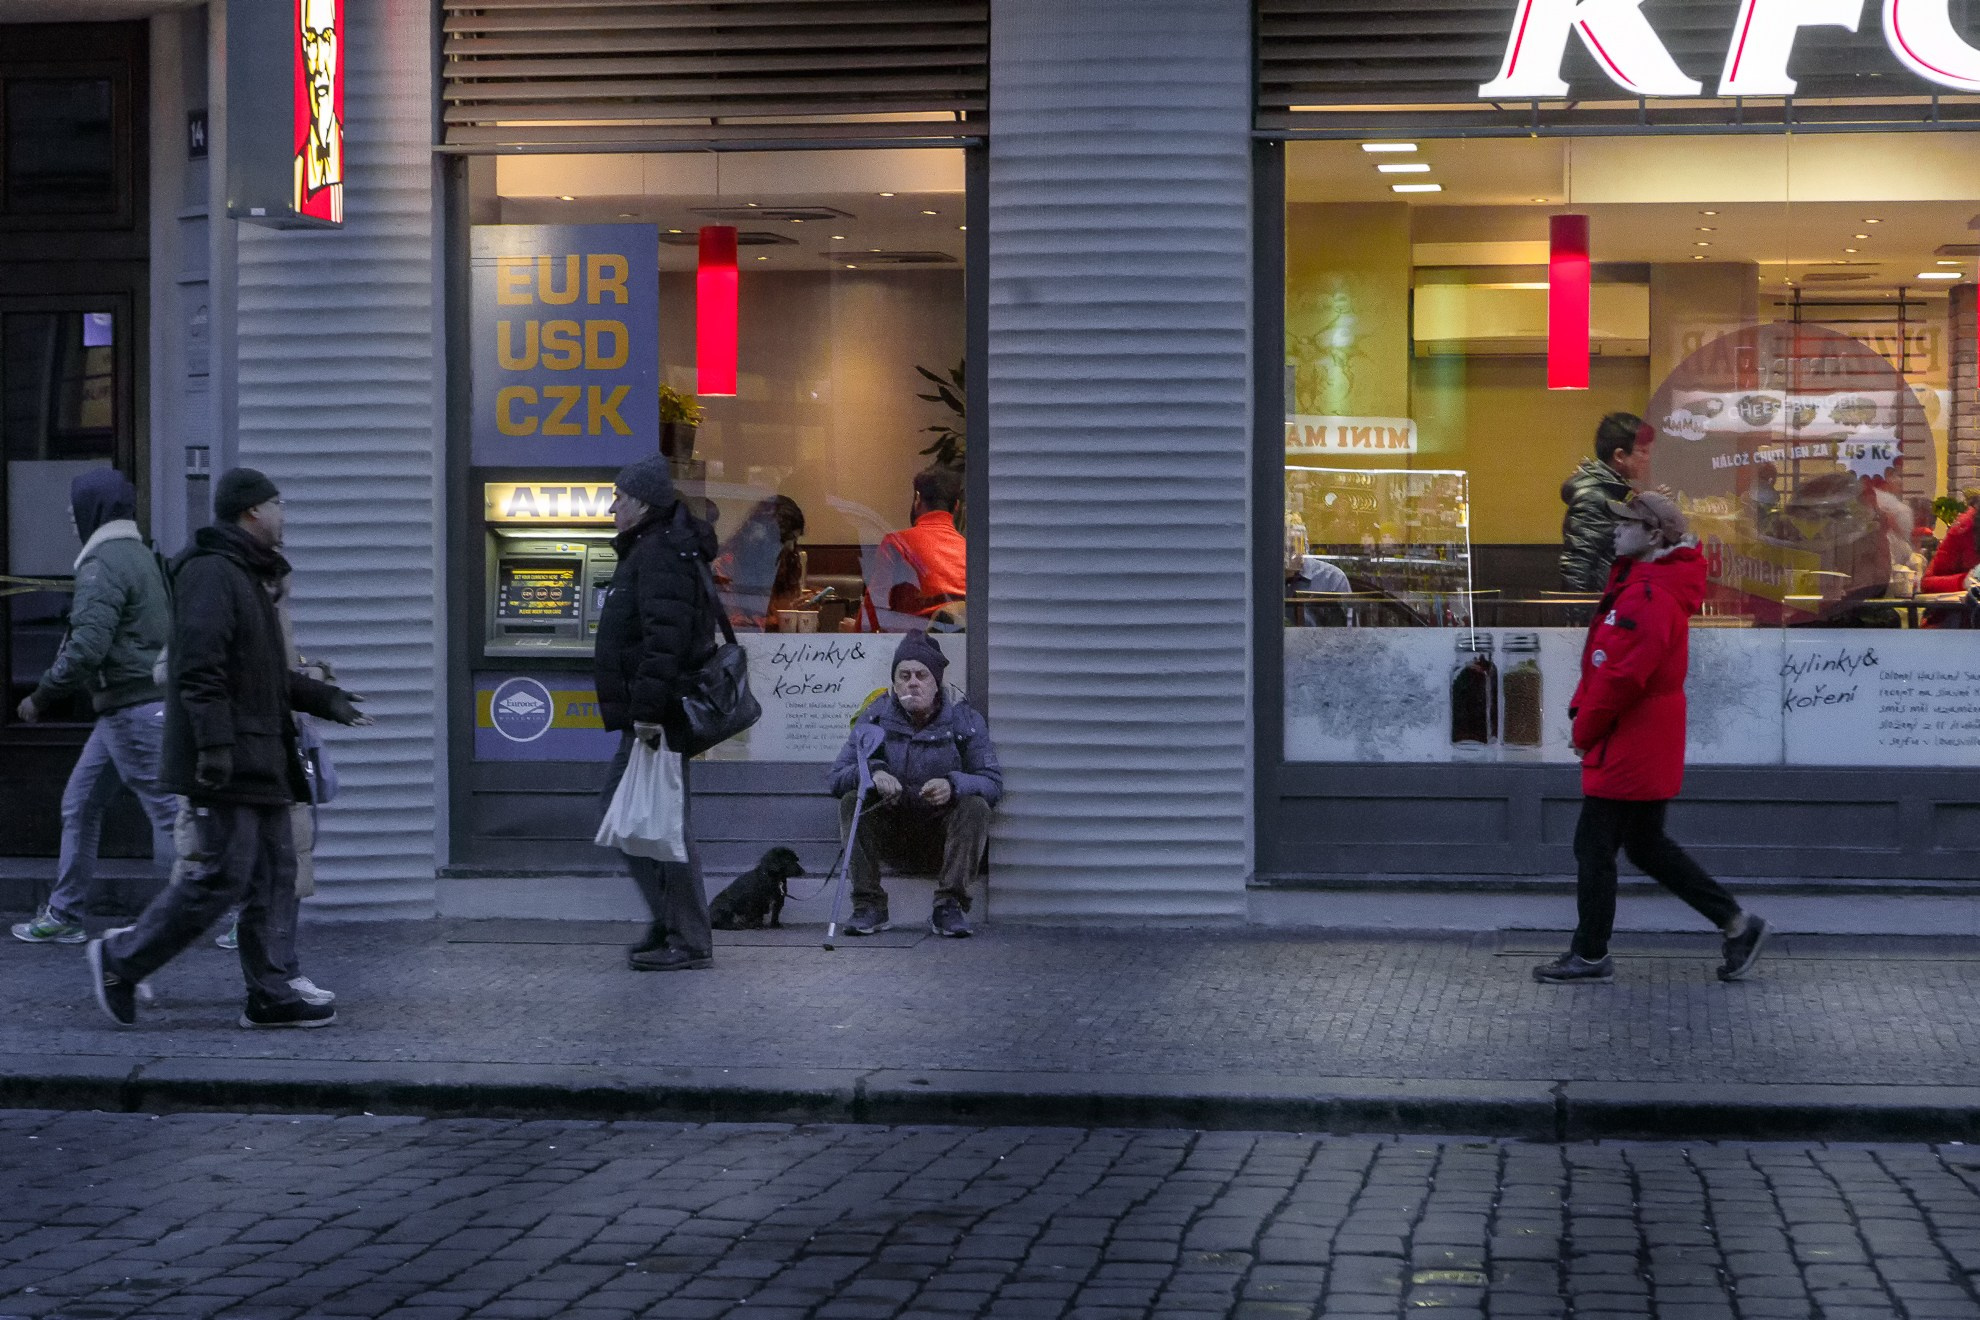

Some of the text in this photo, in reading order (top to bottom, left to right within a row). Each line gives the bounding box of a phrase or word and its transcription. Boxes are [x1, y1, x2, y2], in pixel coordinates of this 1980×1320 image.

[497, 254, 629, 305] EUR
[497, 319, 630, 371] USD
[496, 385, 634, 436] CZK
[1845, 444, 1865, 460] 45
[506, 486, 614, 517] ATM
[773, 674, 845, 699] koření
[1782, 685, 1859, 712] koření
[506, 698, 537, 708] Euronet
